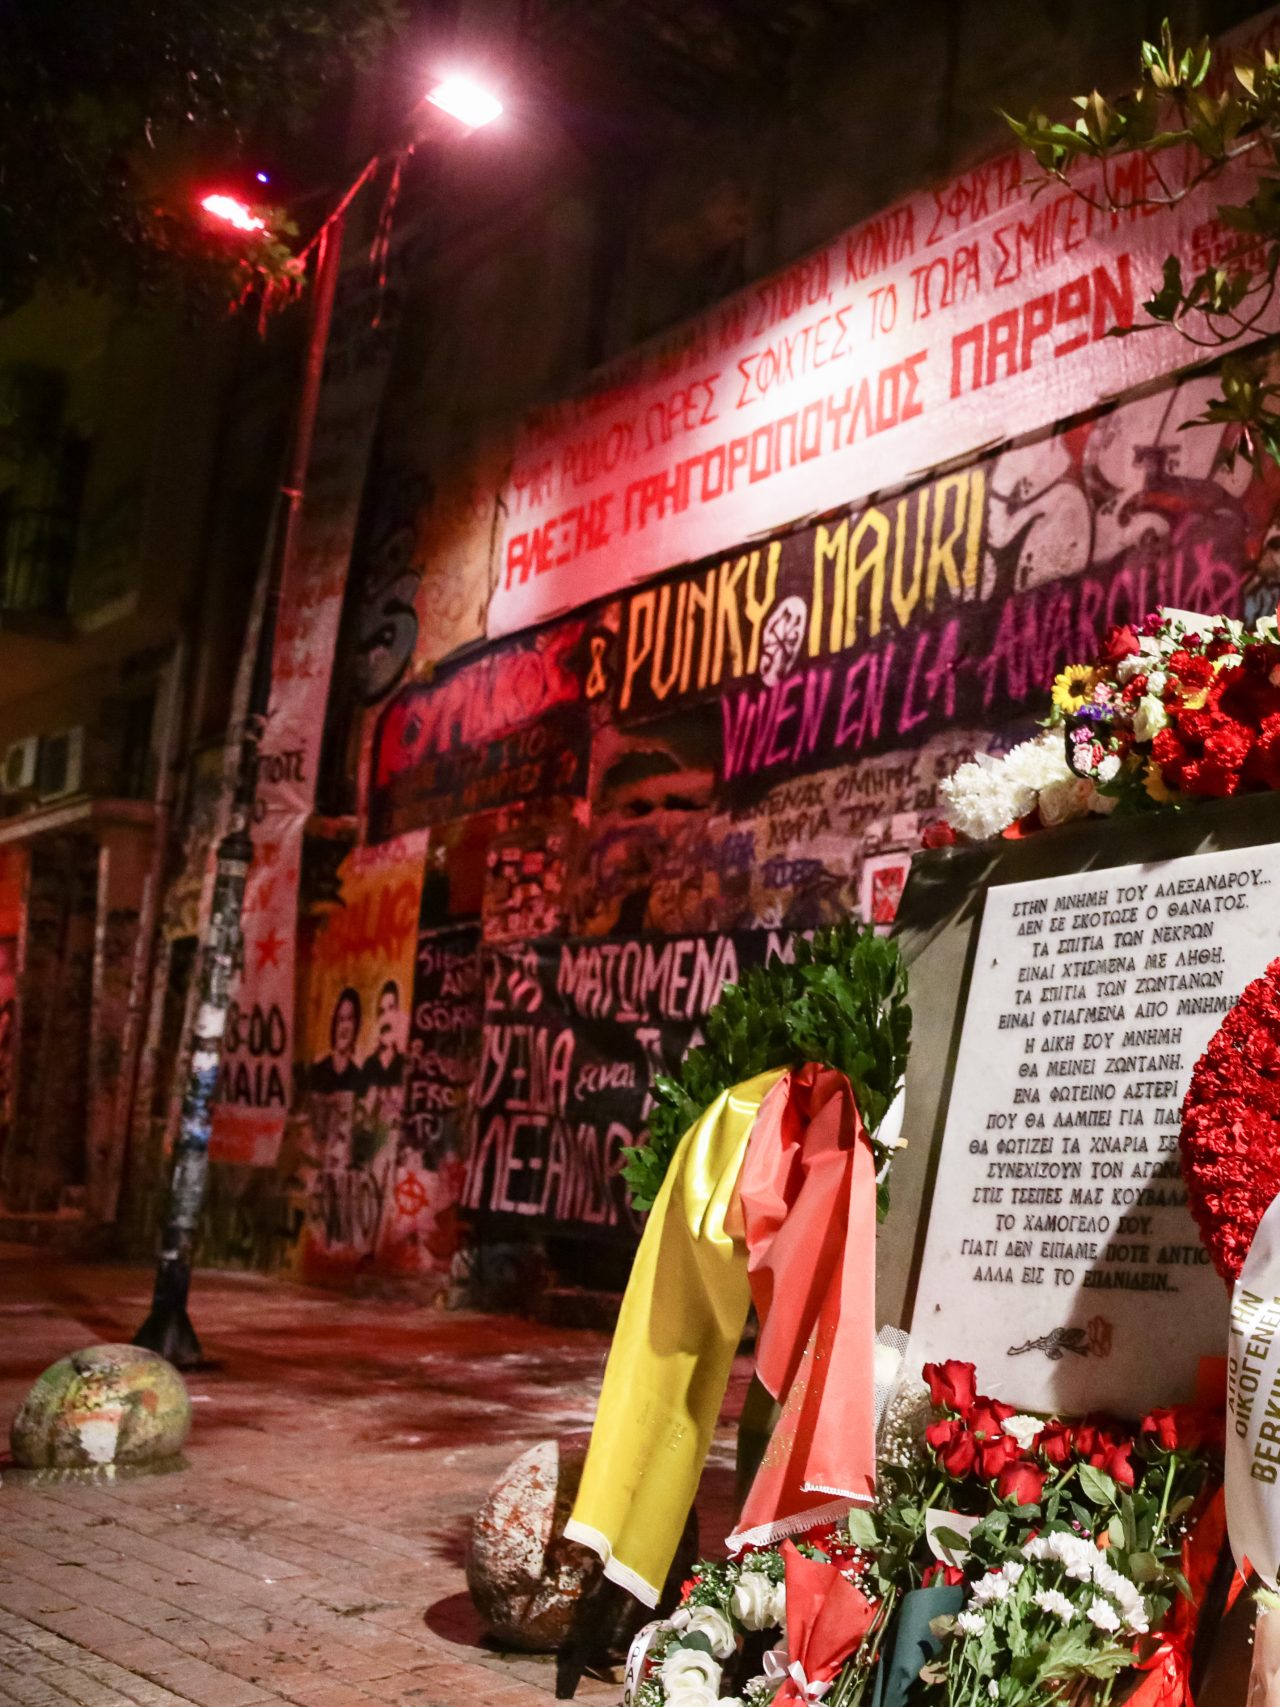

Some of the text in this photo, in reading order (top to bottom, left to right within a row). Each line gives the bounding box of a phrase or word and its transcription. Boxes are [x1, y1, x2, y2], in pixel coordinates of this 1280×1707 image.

[868, 284, 897, 340] ΤΟ
[910, 240, 981, 322] ΤΩΡΑ
[621, 541, 782, 710] PUNKY
[807, 471, 985, 657] MAURI
[1012, 900, 1047, 917] ΣΤΗΝ
[1055, 891, 1108, 912] ΜΝΗΜΗ
[1117, 884, 1148, 902] ΤΟΥ
[1017, 919, 1044, 936] ΔΕΝ
[1049, 916, 1066, 932] ΣΕ
[1072, 908, 1139, 929] ΣΚΟΤΩΣΕ
[1146, 906, 1158, 921] Ο
[1033, 922, 1214, 958] ΤΑ ΣΠΙΤΙΑ ΤΩΝ ΝΕΚΡΩΝ
[1018, 964, 1056, 982] ΕΙΝΑΙ
[1062, 956, 1136, 978] ΧΤΙΣΜΕΝΑ
[1145, 952, 1168, 969] ΜΕ
[1015, 971, 1224, 1005] ΤΑ ΣΠΙΤΙΑ ΤΩΝ ΖΩΝΤΑΝΩΝ
[998, 1010, 1035, 1030] ΕΙΝΑΙ
[1042, 1005, 1126, 1027] ΦΤΙΑΓΜΕΝΑ
[1134, 1001, 1169, 1019] ΑΠΟ
[1024, 1028, 1183, 1054] Η ΔΙΚΗ ΣΟΥ ΜΝΗΜΗ
[1018, 1063, 1038, 1078] ΘΑ
[1046, 1059, 1096, 1078] ΜΕΙΝΕΙ
[1013, 1081, 1178, 1104] ΕΝΑ ΦΩΤΕΙΝΟ ΑΣΤΕΡΙ
[986, 1113, 1018, 1130] ΠΟΥ
[1025, 1113, 1045, 1128] ΘΑ
[1053, 1110, 1112, 1128] ΛΑΜΠΕΙ
[1119, 1108, 1144, 1126] ΓΙΑ
[969, 1140, 989, 1155] ΘΑ
[997, 1137, 1053, 1155] ΦΩΤΙΖΕΙ
[1062, 1137, 1080, 1153] ΤΑ
[1090, 1136, 1148, 1153] ΧΝΑΡΙΑ
[987, 1162, 1082, 1180] ΣΥΝΕΧΙΖΟΥΝ
[1092, 1161, 1123, 1179] ΤΟΝ
[972, 1187, 1005, 1204] ΣΤΙΣ
[1012, 1188, 1063, 1204] ΤΣΕΠΕΣ
[1070, 1188, 1104, 1205] ΜΑΣ
[996, 1214, 1015, 1231] ΤΟ
[1023, 1215, 1110, 1235] ΧΑΜΟΓΕΛΟ
[961, 1239, 998, 1255] ΓΙΑΤΙ
[1005, 1240, 1033, 1258] ΔΕΝ
[1041, 1242, 1098, 1261] ΕΙΠΑΜΕ
[973, 1267, 1013, 1283] ΑΛΛΑ
[1021, 1268, 1044, 1284] ΕΙΣ
[1054, 1269, 1075, 1286] ΤΟ
